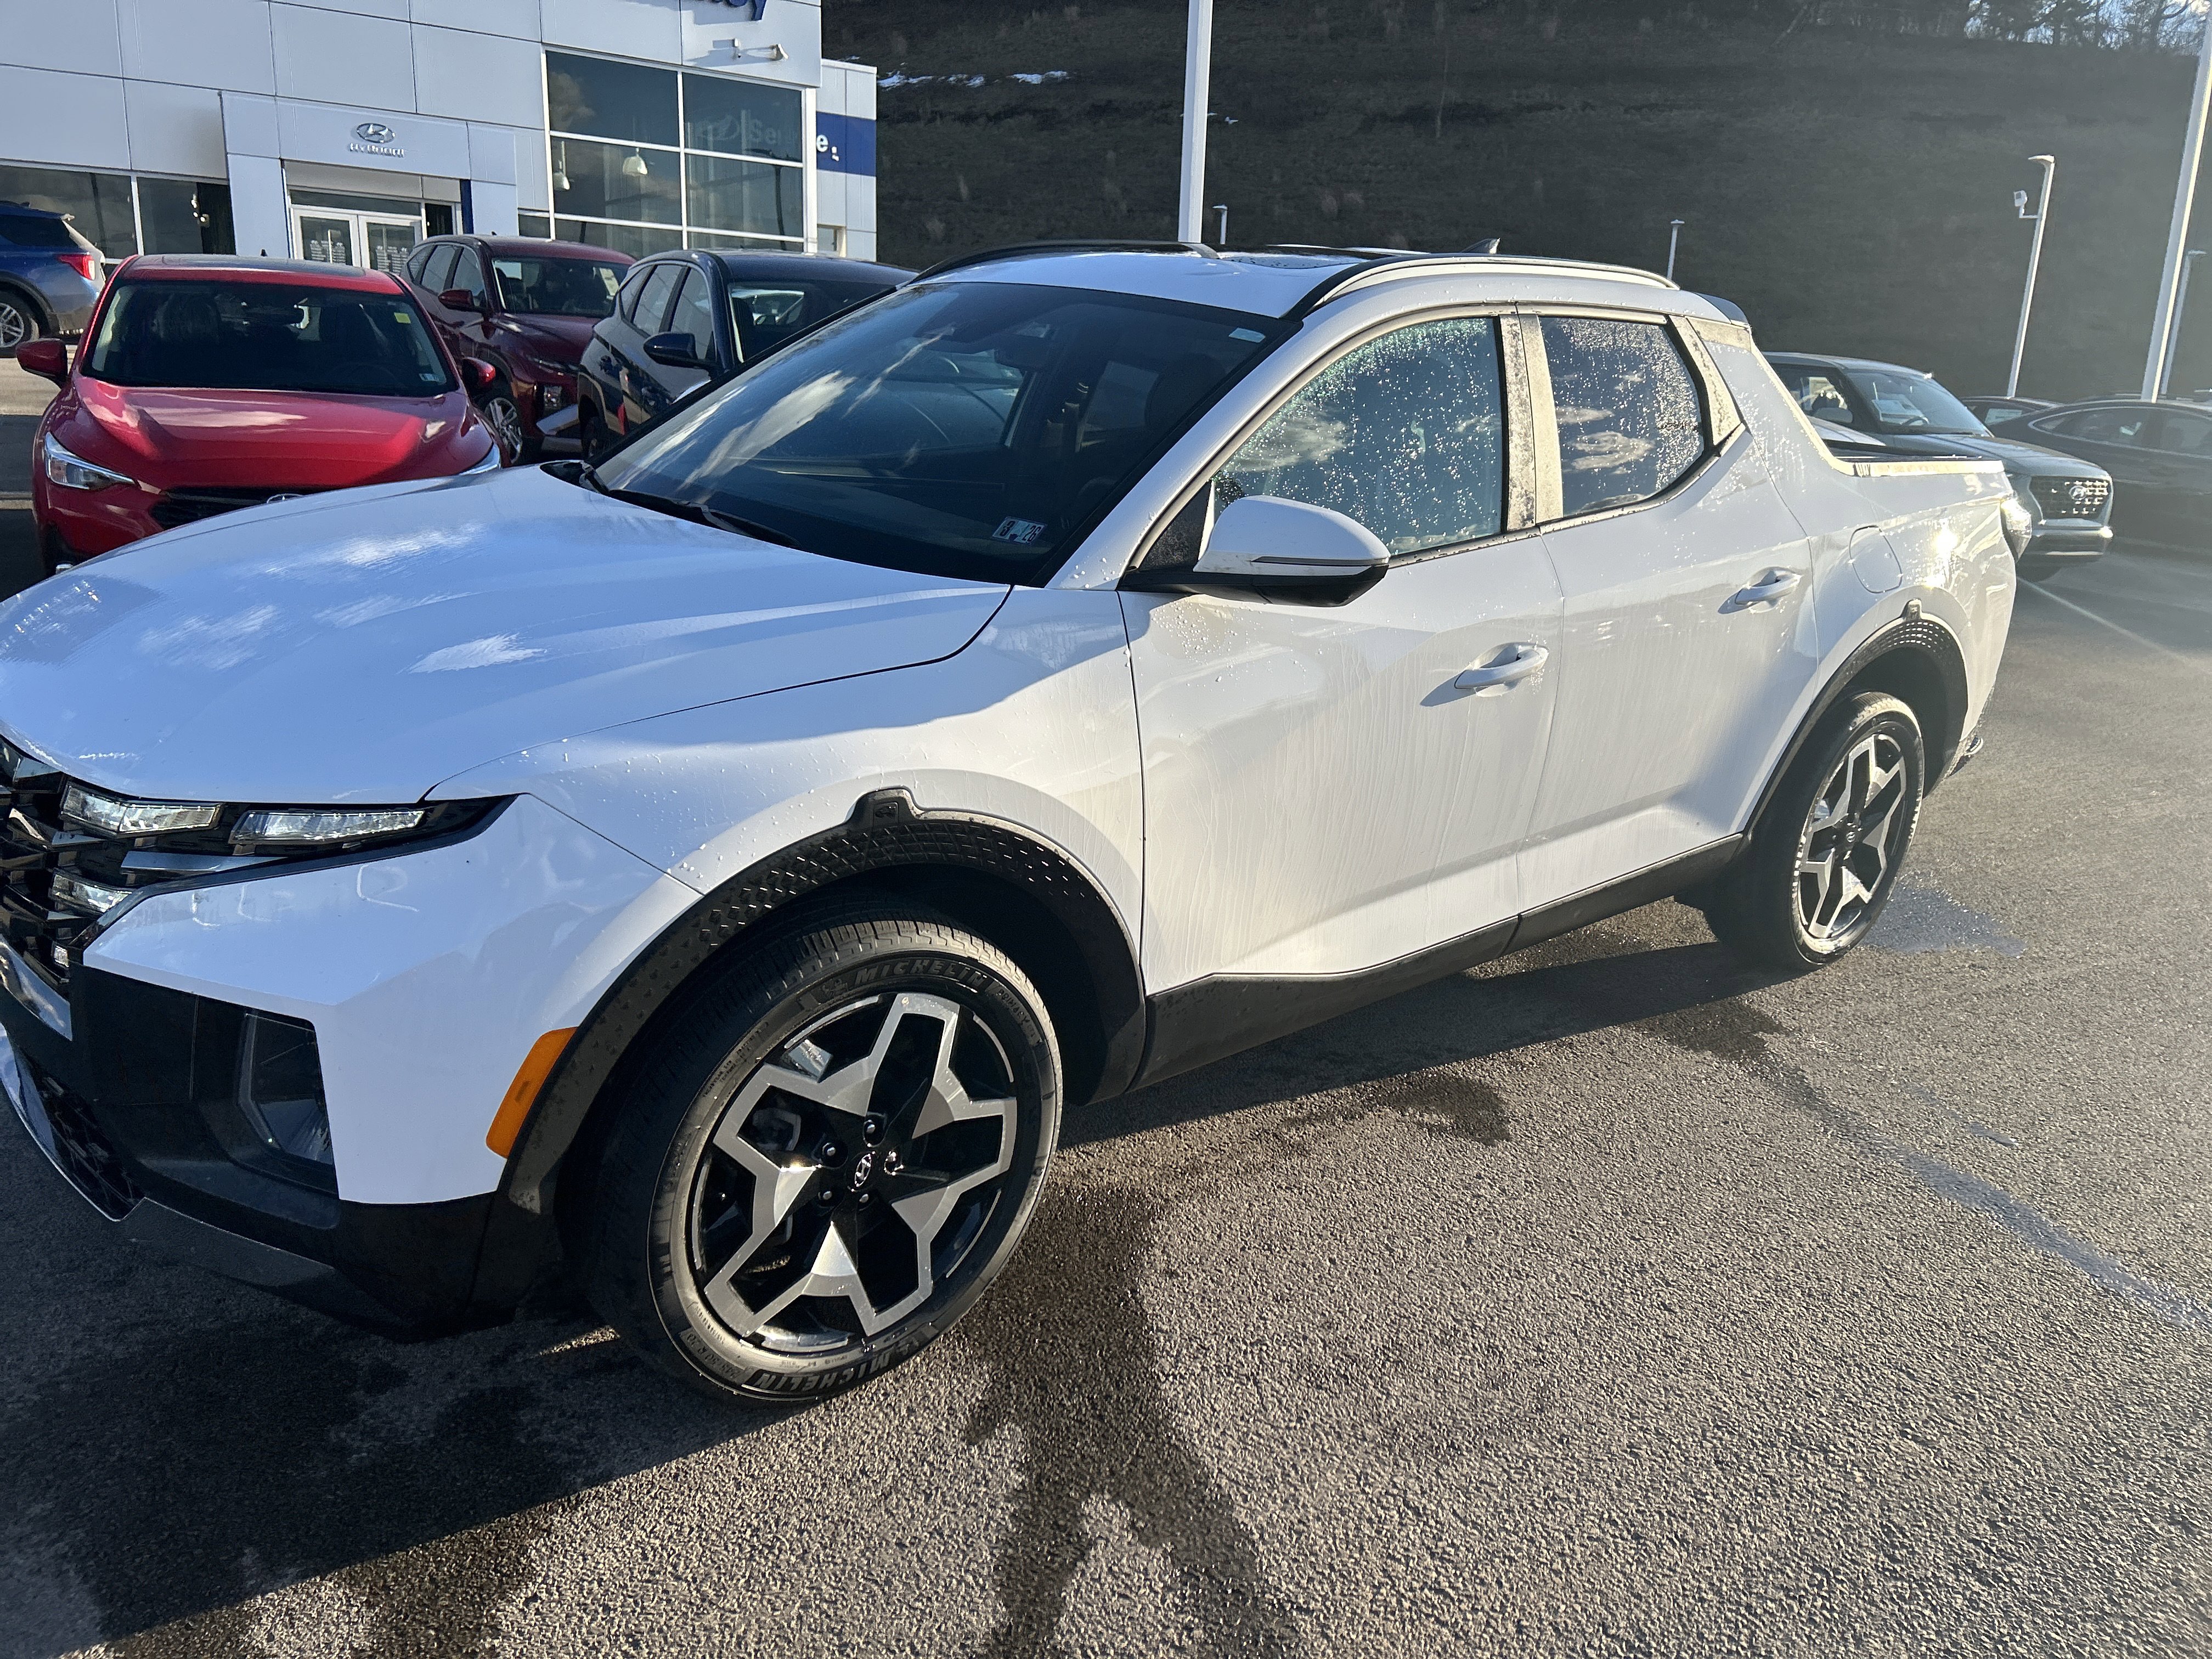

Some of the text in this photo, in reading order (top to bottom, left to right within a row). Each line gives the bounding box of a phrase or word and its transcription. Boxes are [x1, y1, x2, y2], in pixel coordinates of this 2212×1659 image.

[1022, 525, 1042, 542] 26
[854, 959, 986, 987] MICHELIN
[997, 989, 1030, 1025] PRIMACY
[753, 1352, 891, 1392] MICHELIN
